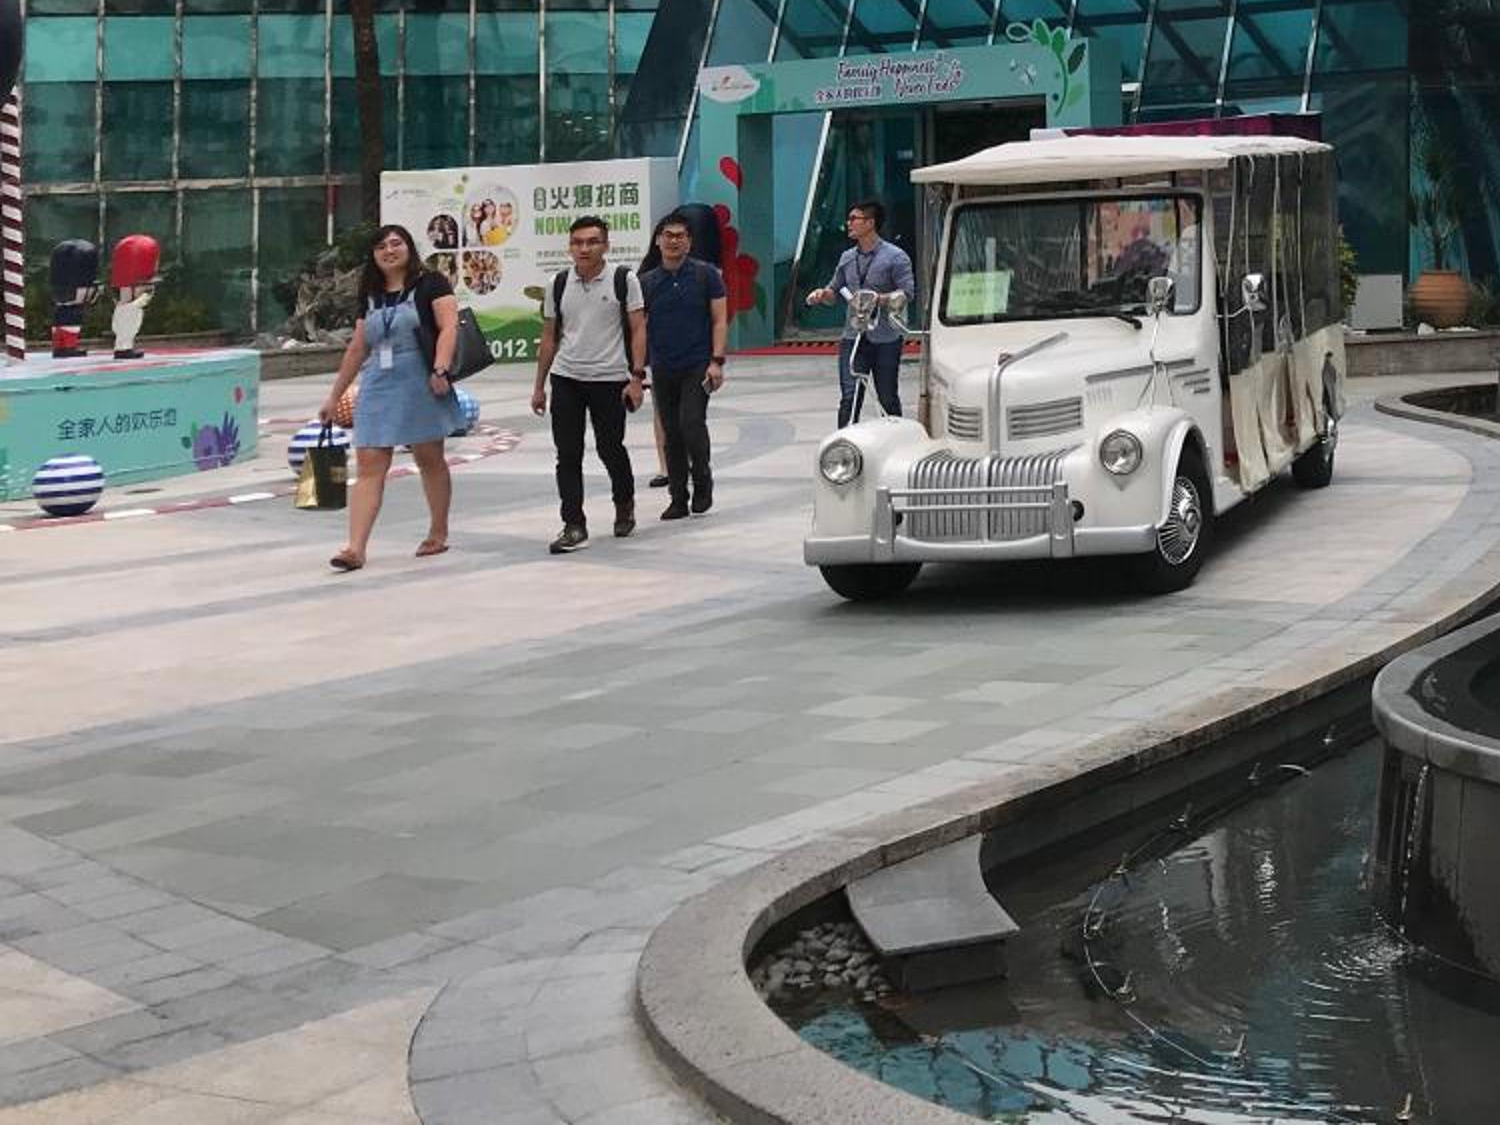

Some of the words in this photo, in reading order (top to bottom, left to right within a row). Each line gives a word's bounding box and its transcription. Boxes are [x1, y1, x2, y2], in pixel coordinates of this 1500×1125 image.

[550, 182, 639, 210] 火爆招商
[535, 216, 572, 235] NOW
[486, 338, 527, 358] 012
